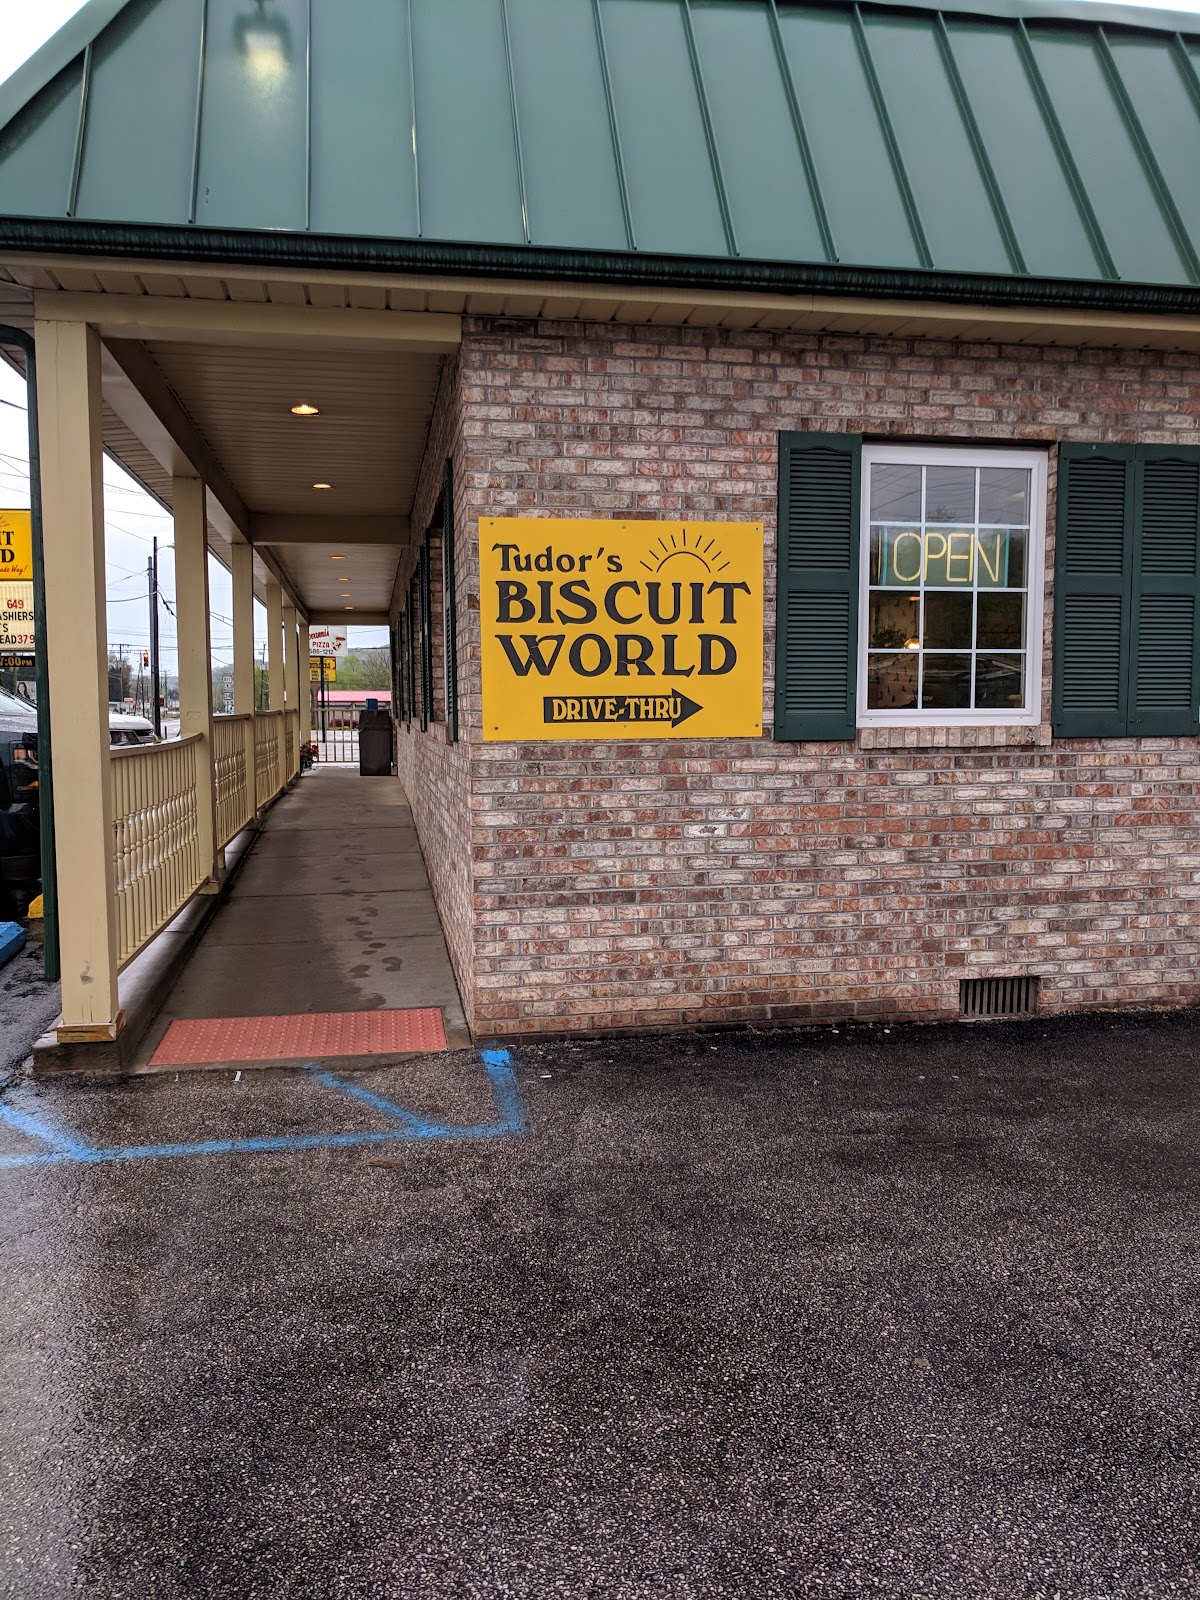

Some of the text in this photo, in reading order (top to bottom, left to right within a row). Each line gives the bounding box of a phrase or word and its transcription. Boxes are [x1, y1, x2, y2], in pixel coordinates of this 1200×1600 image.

[11, 564, 27, 576] Way!
[491, 543, 623, 573] Tudor's
[893, 532, 1001, 583] OPEN
[7, 599, 24, 609] 649
[495, 579, 751, 625] BISCUIT
[0, 611, 34, 621] SHIERS
[495, 633, 737, 677] WORLD
[552, 697, 682, 721] DRIVE-THRU
